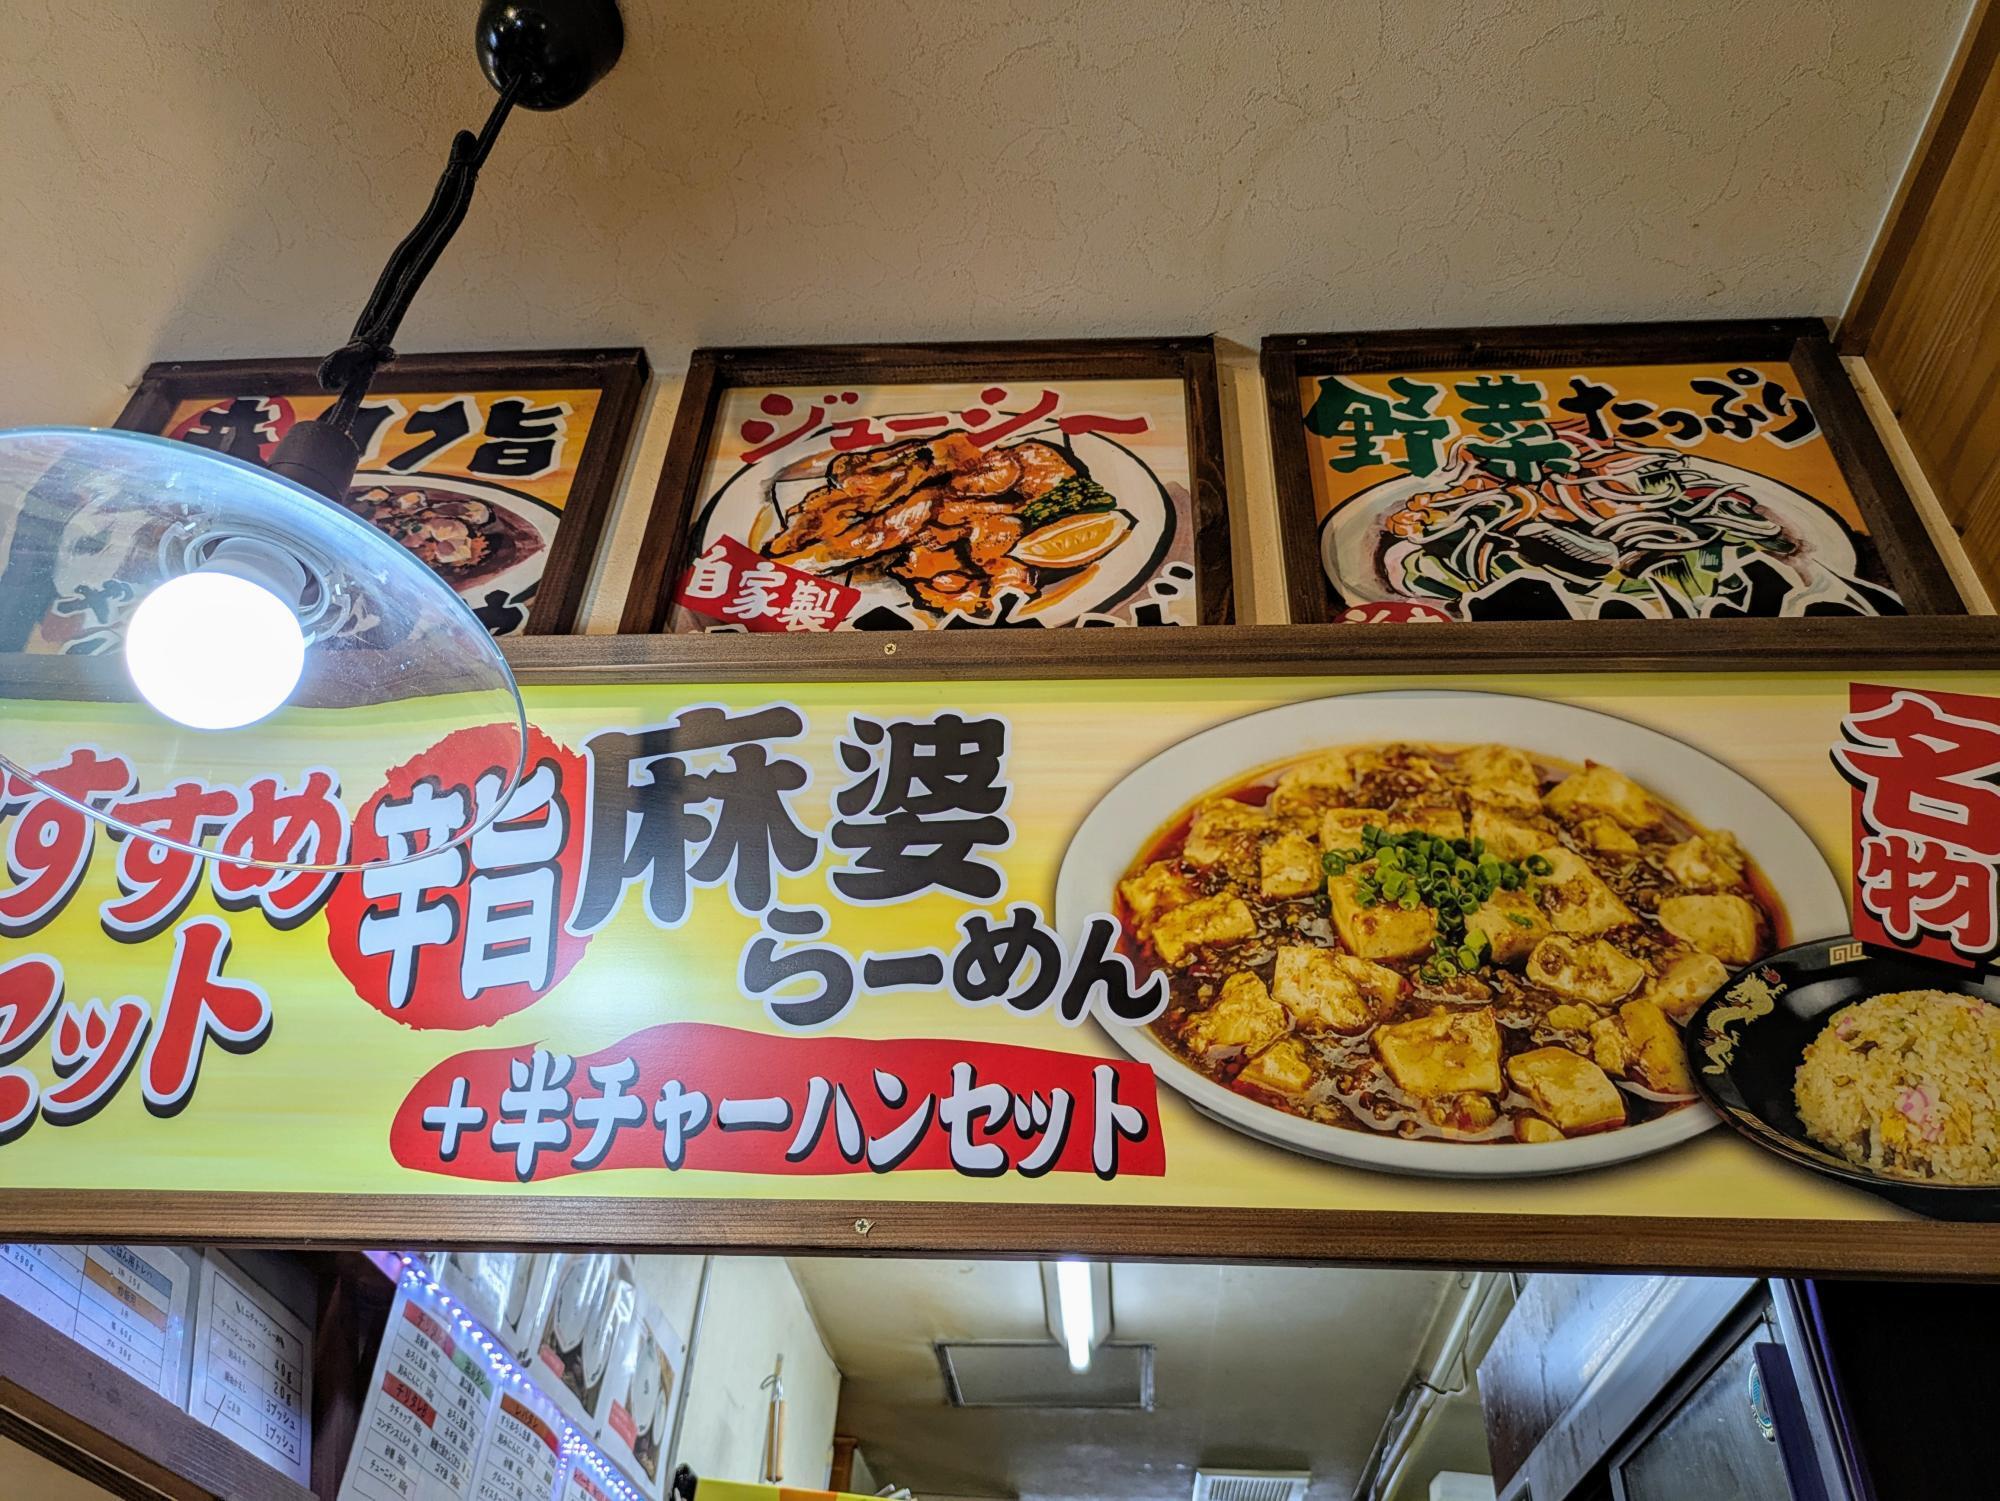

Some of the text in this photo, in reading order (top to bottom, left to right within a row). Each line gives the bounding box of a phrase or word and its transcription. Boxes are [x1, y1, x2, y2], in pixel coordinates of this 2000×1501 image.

[740, 387, 1149, 464] ジューシー
[1304, 367, 1819, 481] 野菜たっぷり
[684, 552, 841, 632] 自家製
[0, 747, 350, 932] すすめ
[1831, 691, 2000, 954] 名物
[741, 903, 1167, 1029] らーめん
